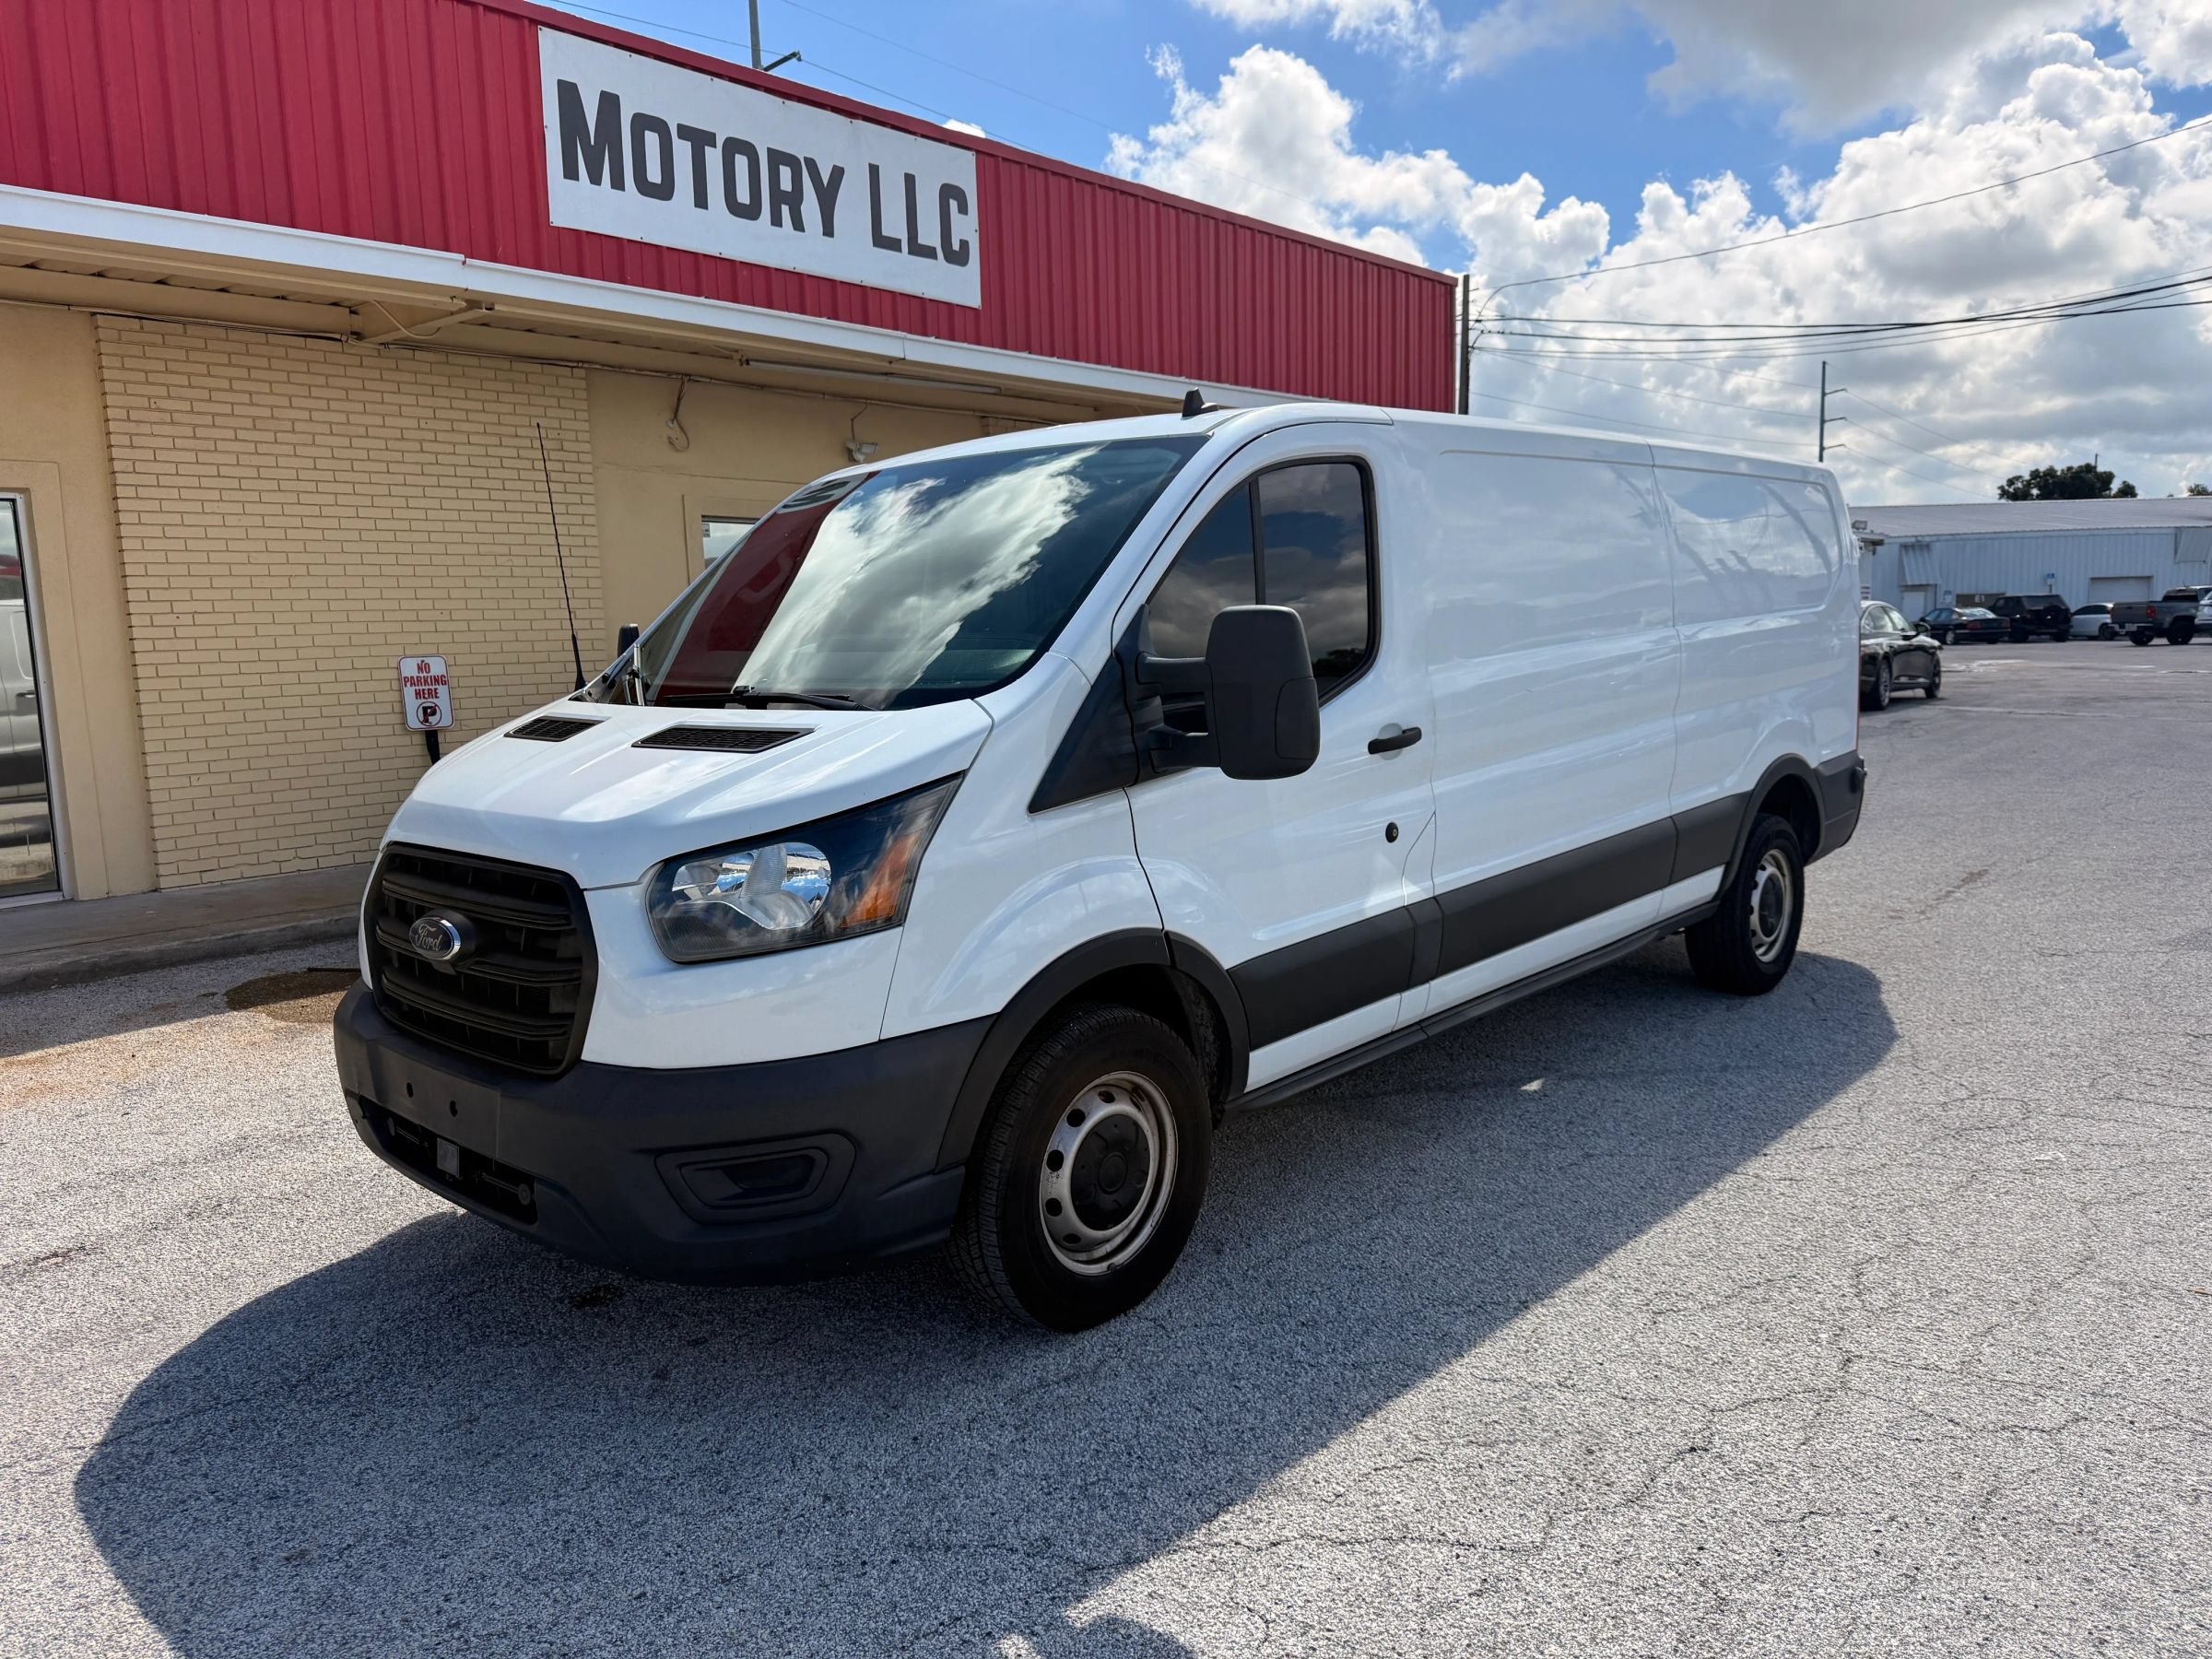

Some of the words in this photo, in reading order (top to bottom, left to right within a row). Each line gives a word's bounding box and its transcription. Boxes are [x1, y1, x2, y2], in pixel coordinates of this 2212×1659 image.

[557, 78, 845, 239] MOTORY
[868, 162, 971, 267] LLC
[417, 662, 430, 674] NO
[403, 675, 448, 687] PARKING
[414, 688, 440, 700] HERE
[415, 924, 443, 952] Ford
